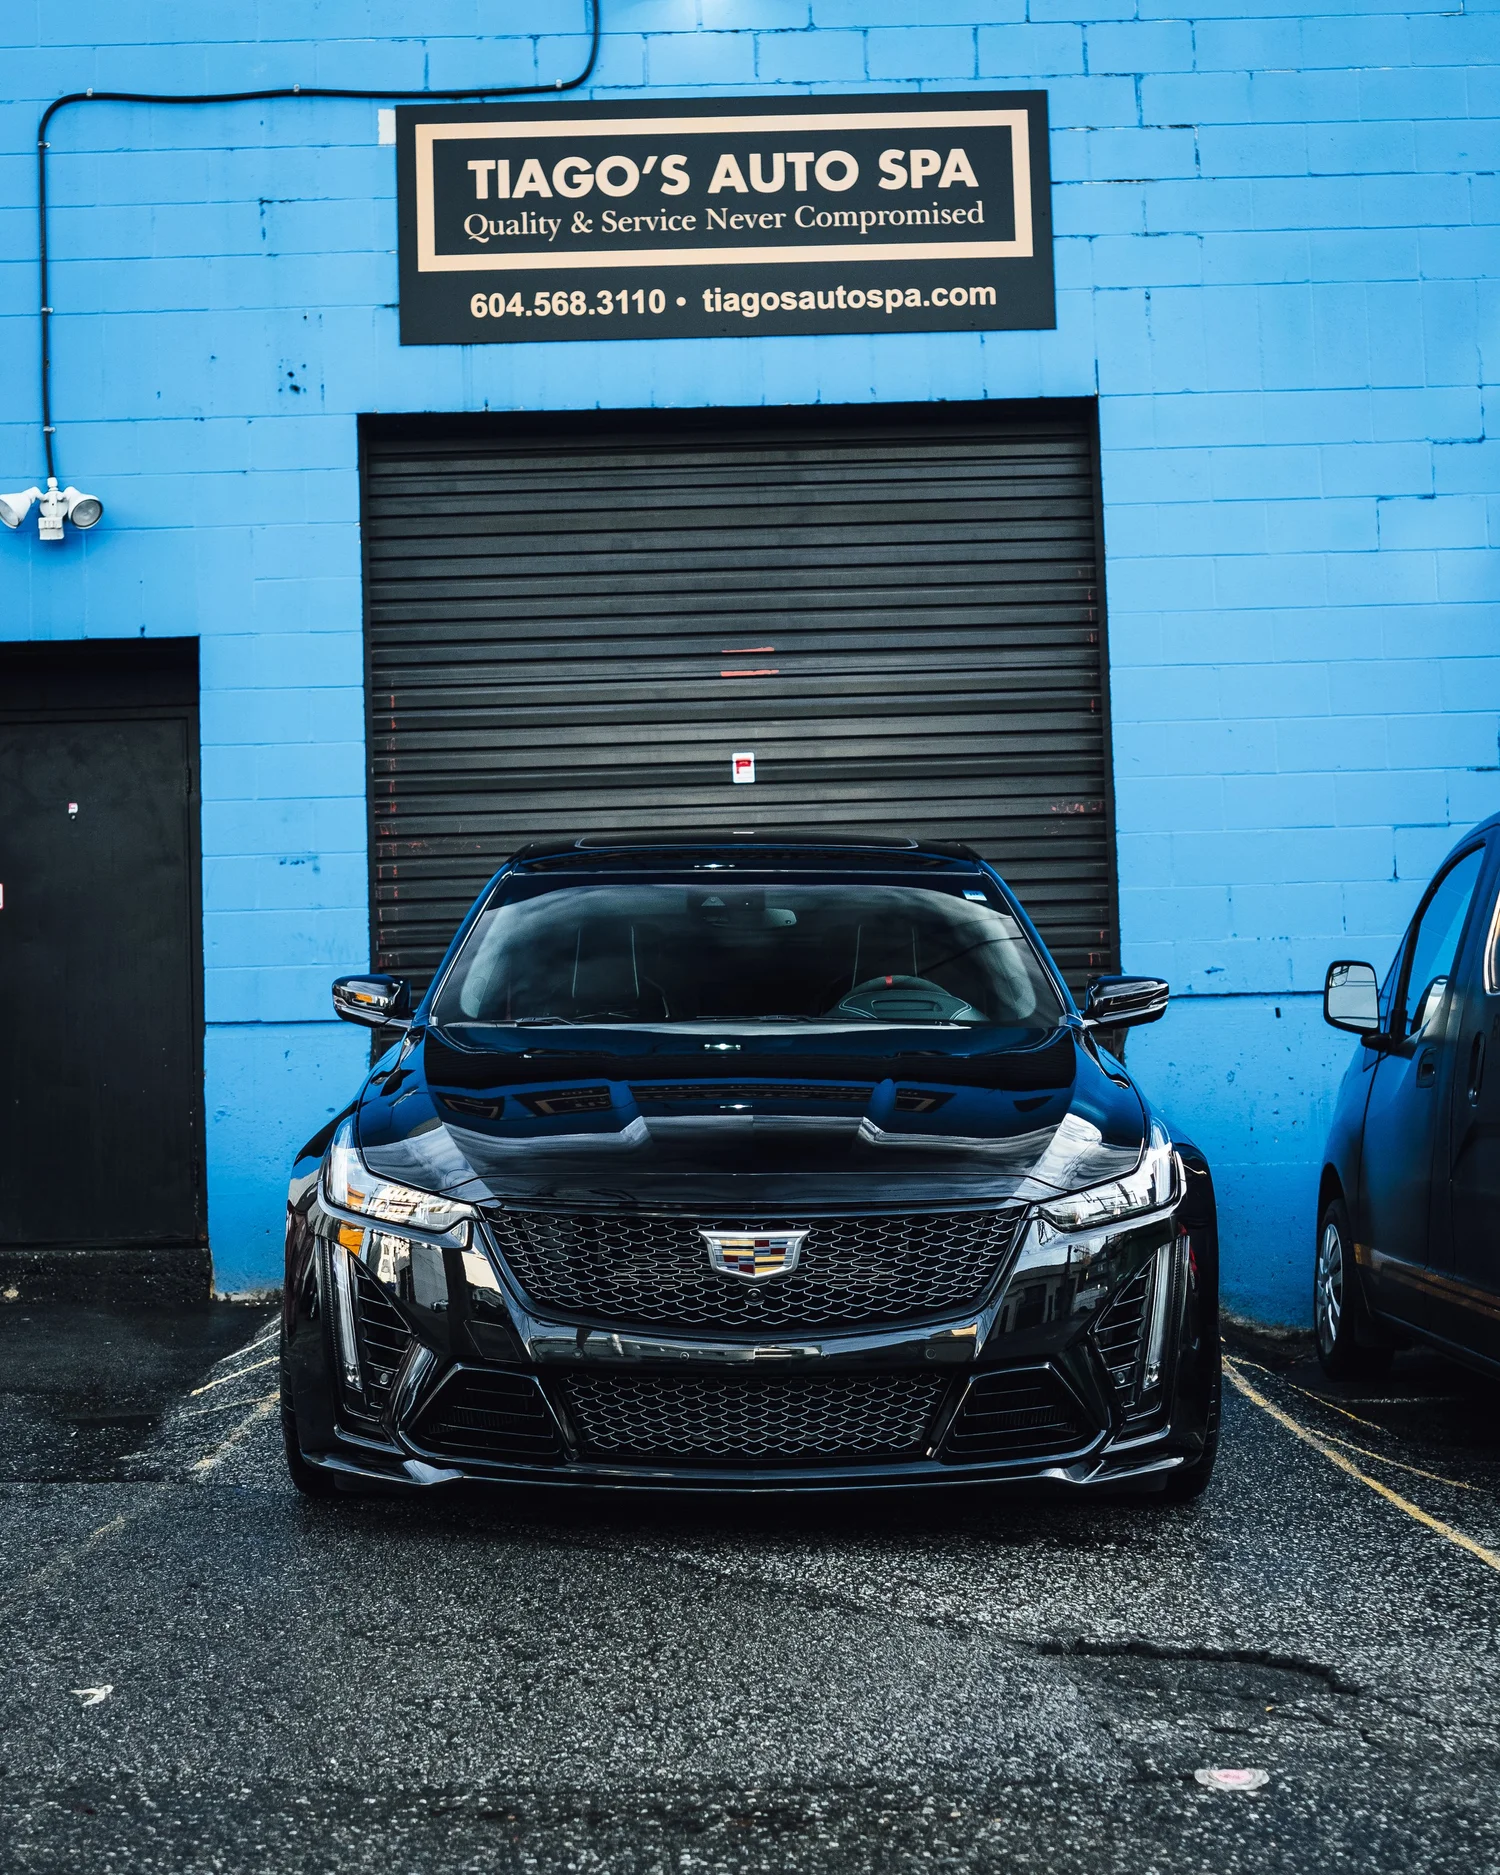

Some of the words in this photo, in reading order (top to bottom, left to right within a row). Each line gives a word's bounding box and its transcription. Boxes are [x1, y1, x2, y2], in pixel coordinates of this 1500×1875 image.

[467, 153, 691, 200] TIAGO'S
[708, 149, 860, 195] AUTO
[878, 148, 980, 191] SPA
[463, 211, 562, 244] Quality
[570, 210, 593, 234] &
[601, 207, 697, 233] Service
[705, 205, 787, 230] Never
[794, 200, 985, 235] Compromised
[470, 289, 667, 319] 604.568.3110
[702, 285, 997, 318] tiagosautospa.com
